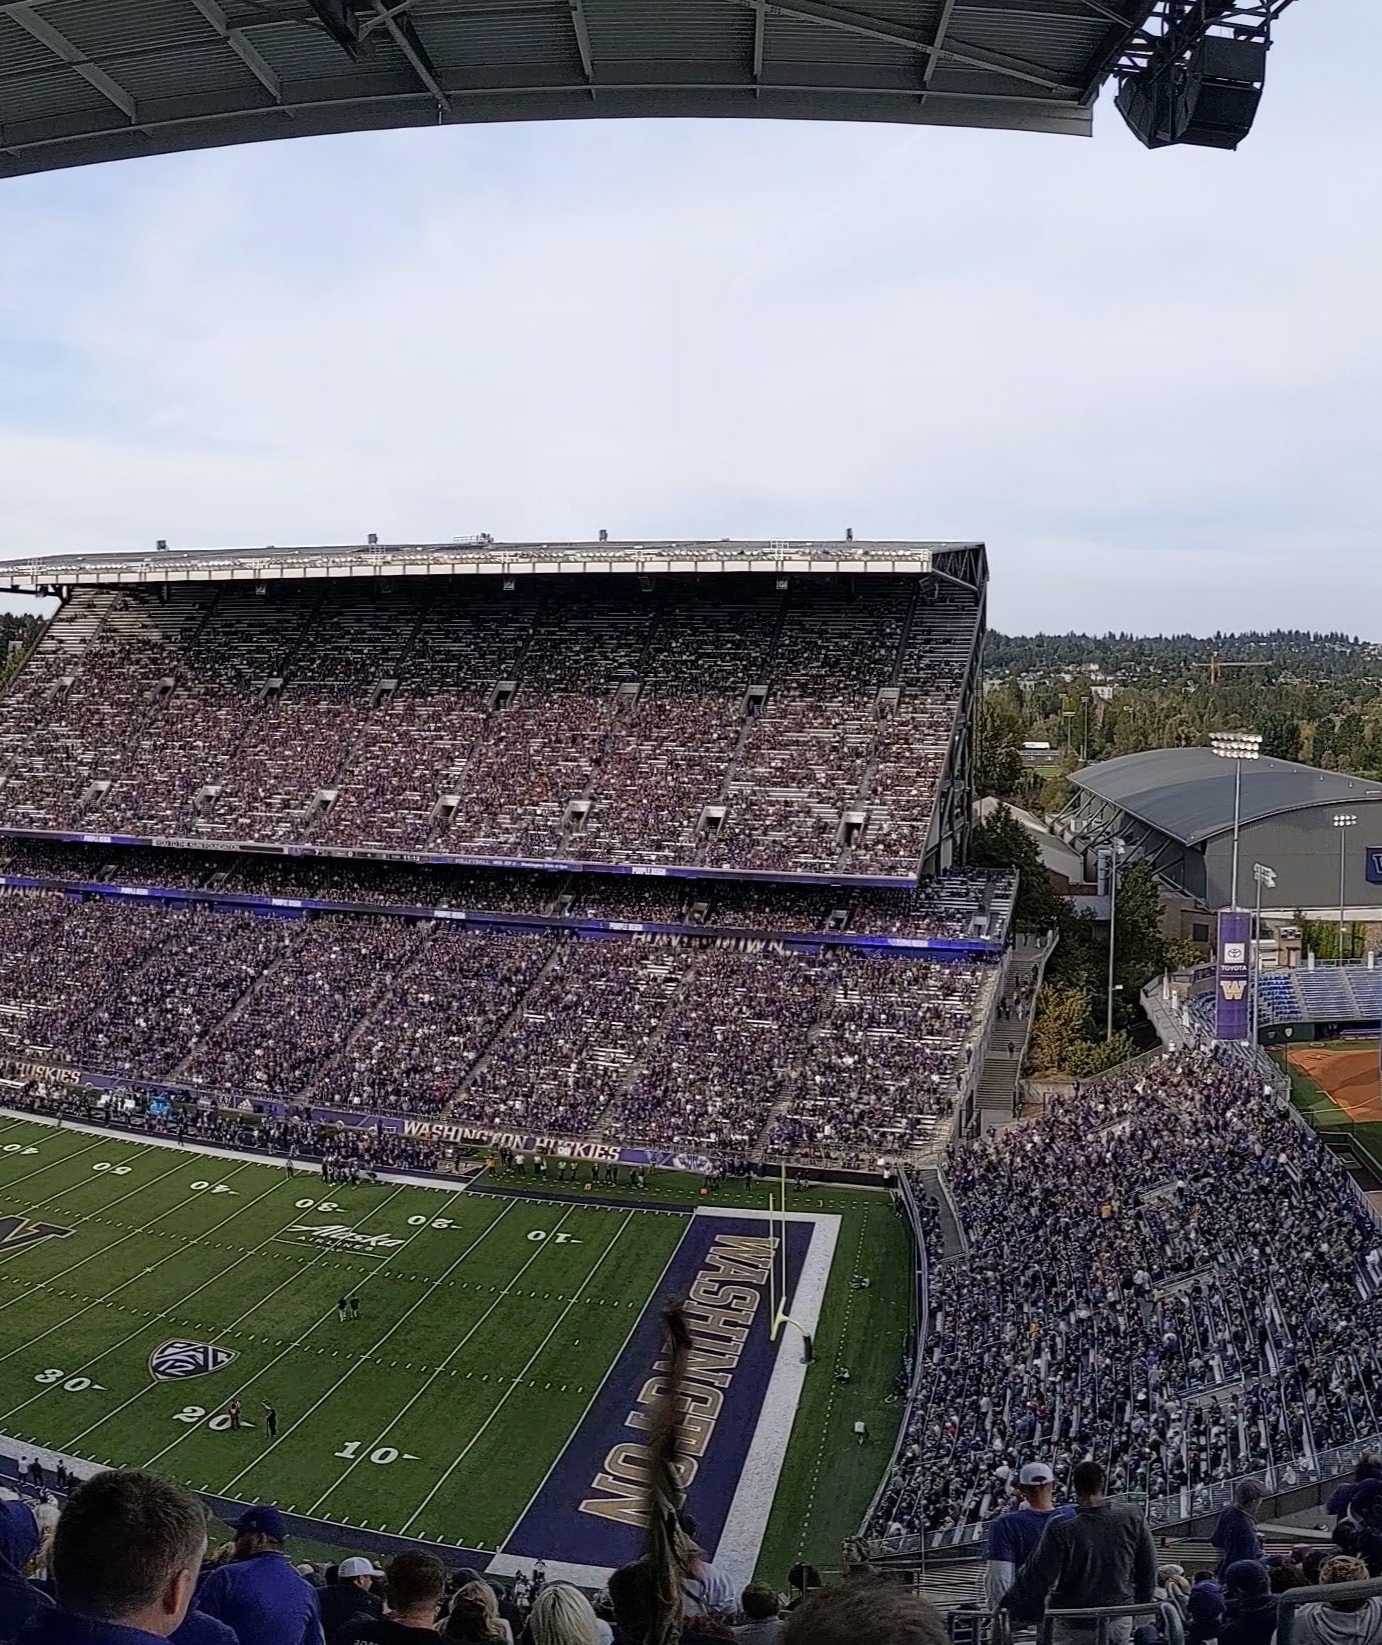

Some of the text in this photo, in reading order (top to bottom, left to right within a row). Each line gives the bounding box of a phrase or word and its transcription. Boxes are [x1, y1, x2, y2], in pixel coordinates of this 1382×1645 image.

[1220, 981, 1247, 1000] W
[403, 1120, 620, 1160] WASHINGTON HUSKIES
[286, 1224, 406, 1248] Alaska
[297, 1235, 375, 1252] AIRLINES
[34, 1368, 92, 1392] 30
[172, 1405, 235, 1431] 20
[334, 1441, 399, 1465] 10
